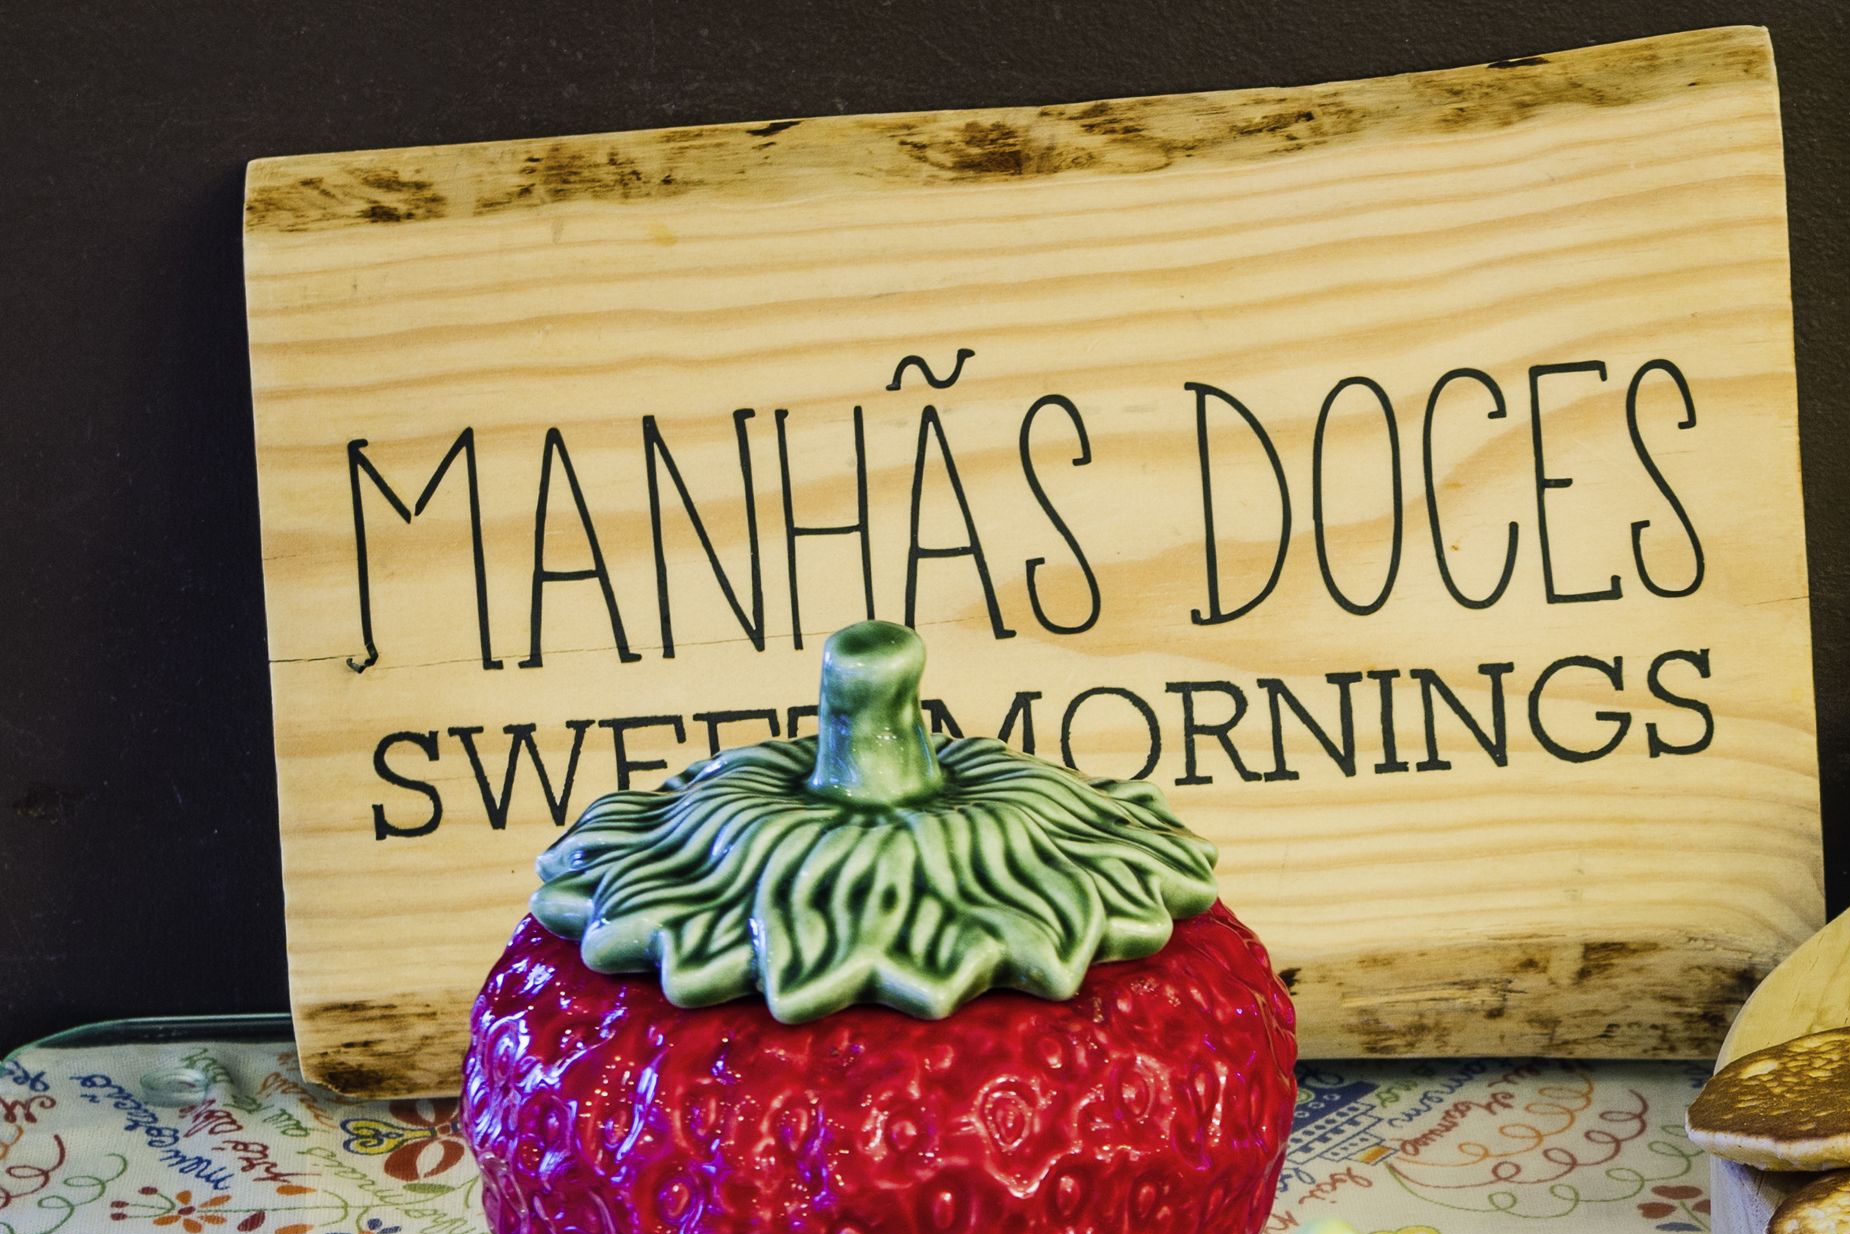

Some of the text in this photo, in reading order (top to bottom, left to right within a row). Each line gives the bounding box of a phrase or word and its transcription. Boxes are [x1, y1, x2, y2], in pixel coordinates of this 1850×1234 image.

[346, 347, 1705, 674] MANHÃS DOCES
[371, 702, 820, 841] SWE
